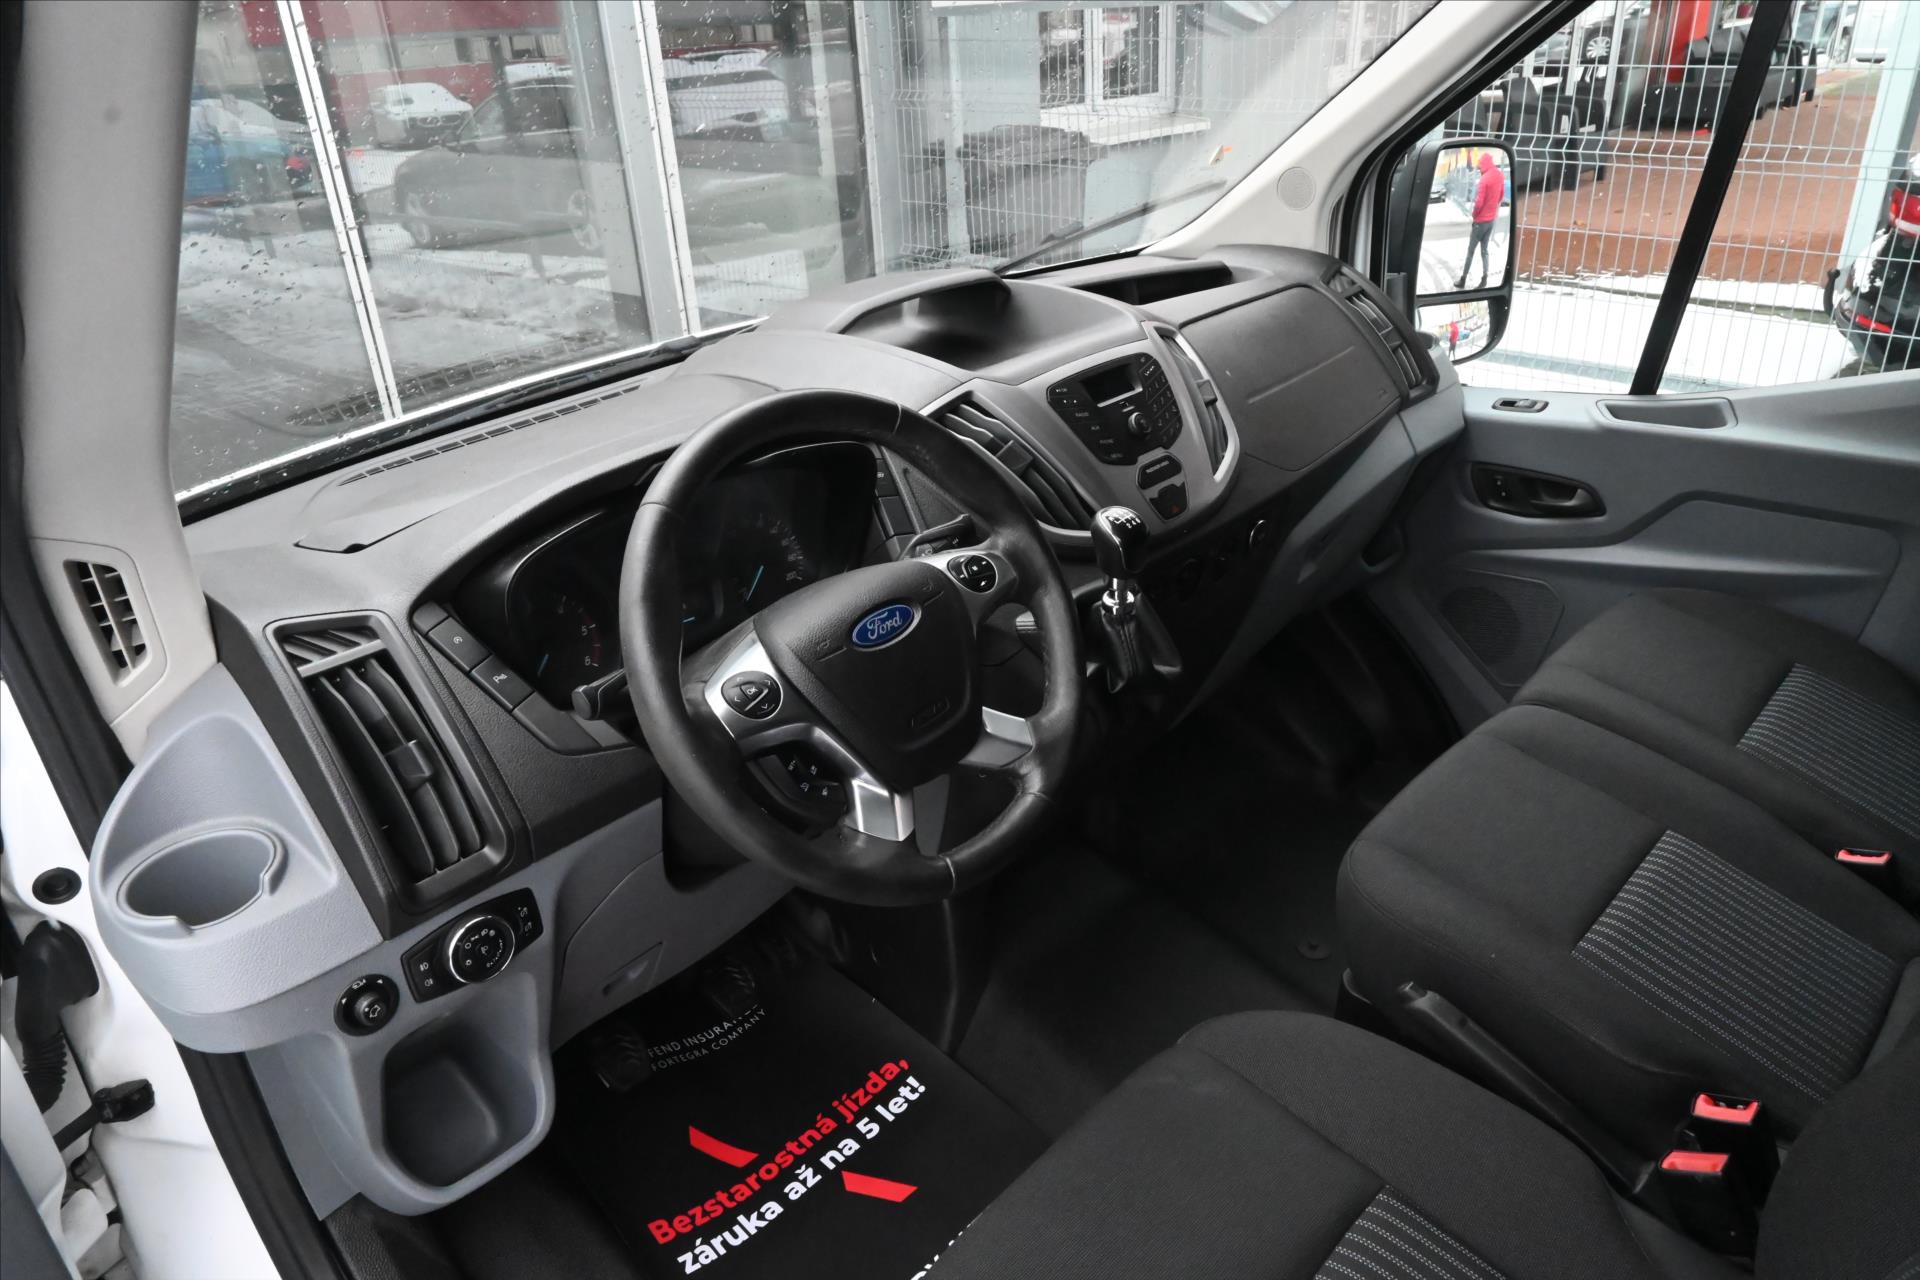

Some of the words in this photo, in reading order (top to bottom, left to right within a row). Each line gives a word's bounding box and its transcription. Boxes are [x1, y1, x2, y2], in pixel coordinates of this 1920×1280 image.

[866, 610, 903, 640] Ford
[746, 686, 759, 695] OK
[682, 1003, 759, 1048] INSURA
[711, 1008, 766, 1050] COMPANY
[647, 1113, 838, 1245] Bezstarostná
[831, 1058, 910, 1124] jízda,
[676, 1200, 785, 1275] záruka
[783, 1163, 823, 1201] až
[819, 1138, 861, 1171] na
[855, 1116, 880, 1140] 5
[874, 1075, 926, 1122] let!
